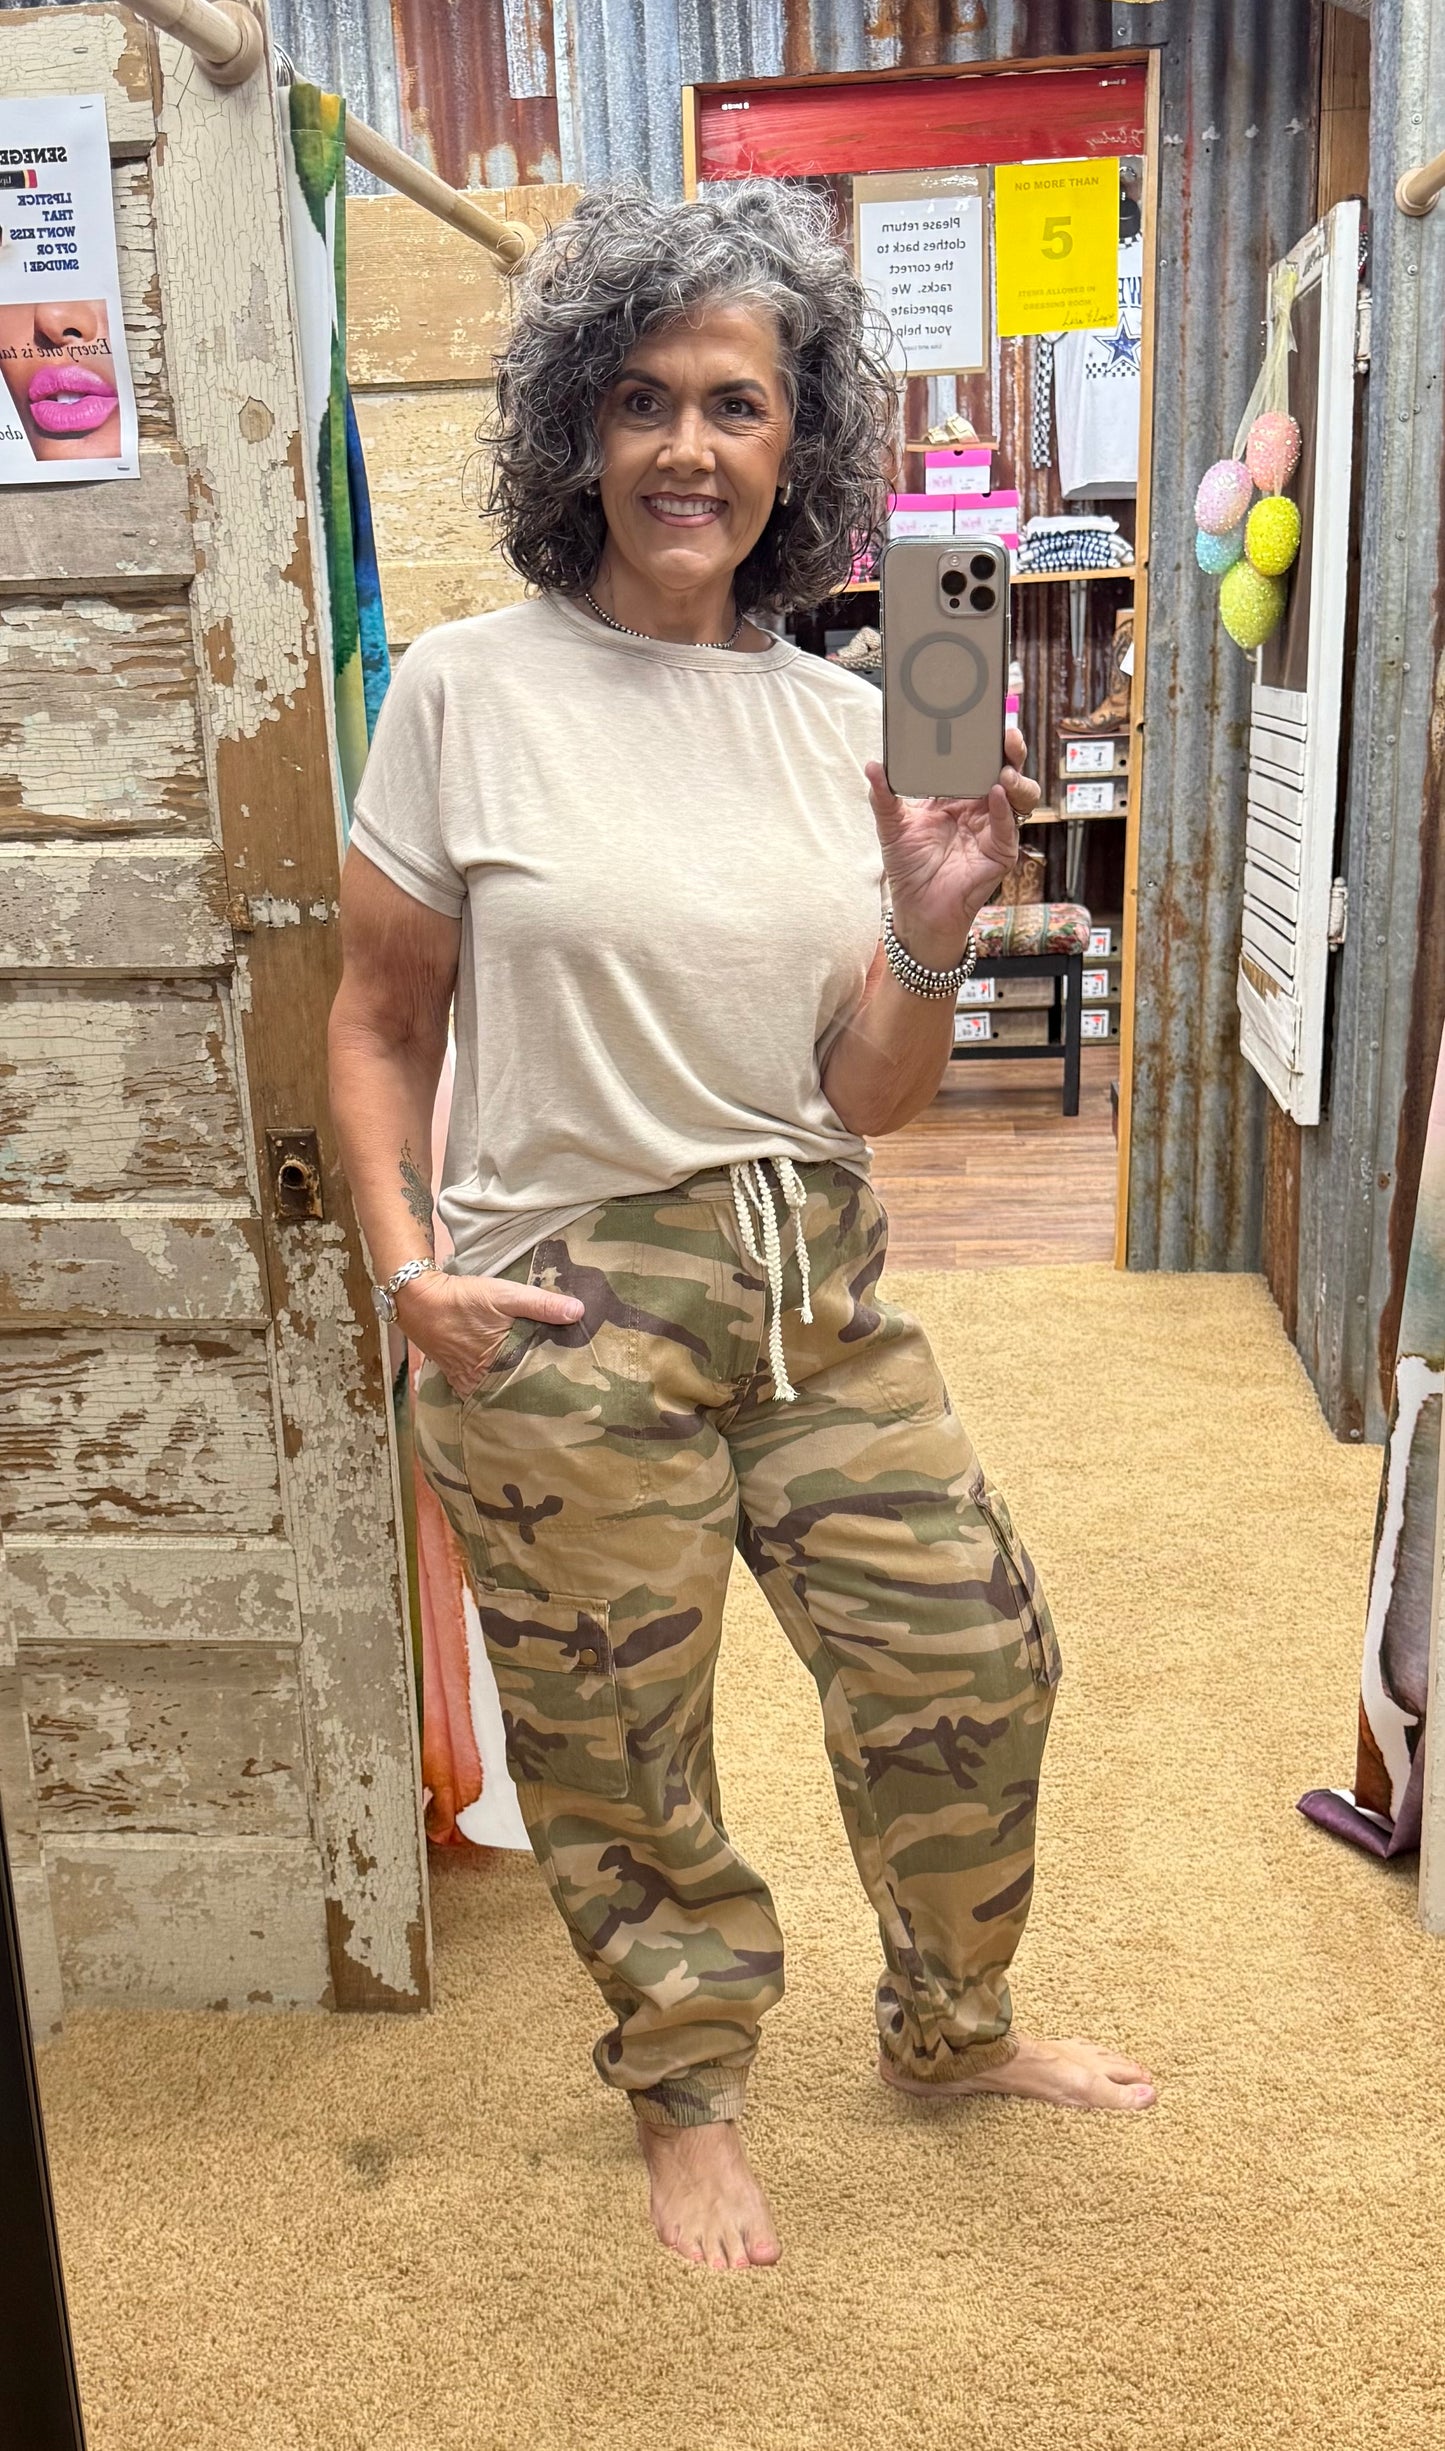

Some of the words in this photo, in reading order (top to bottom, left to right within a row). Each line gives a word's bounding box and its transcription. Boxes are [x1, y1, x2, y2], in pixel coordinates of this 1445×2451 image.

[1015, 182, 1031, 191] NO
[1034, 179, 1065, 190] MORE
[1069, 177, 1099, 188] THAN
[1041, 216, 1073, 260] 5
[1046, 286, 1085, 296] ALLOWED
